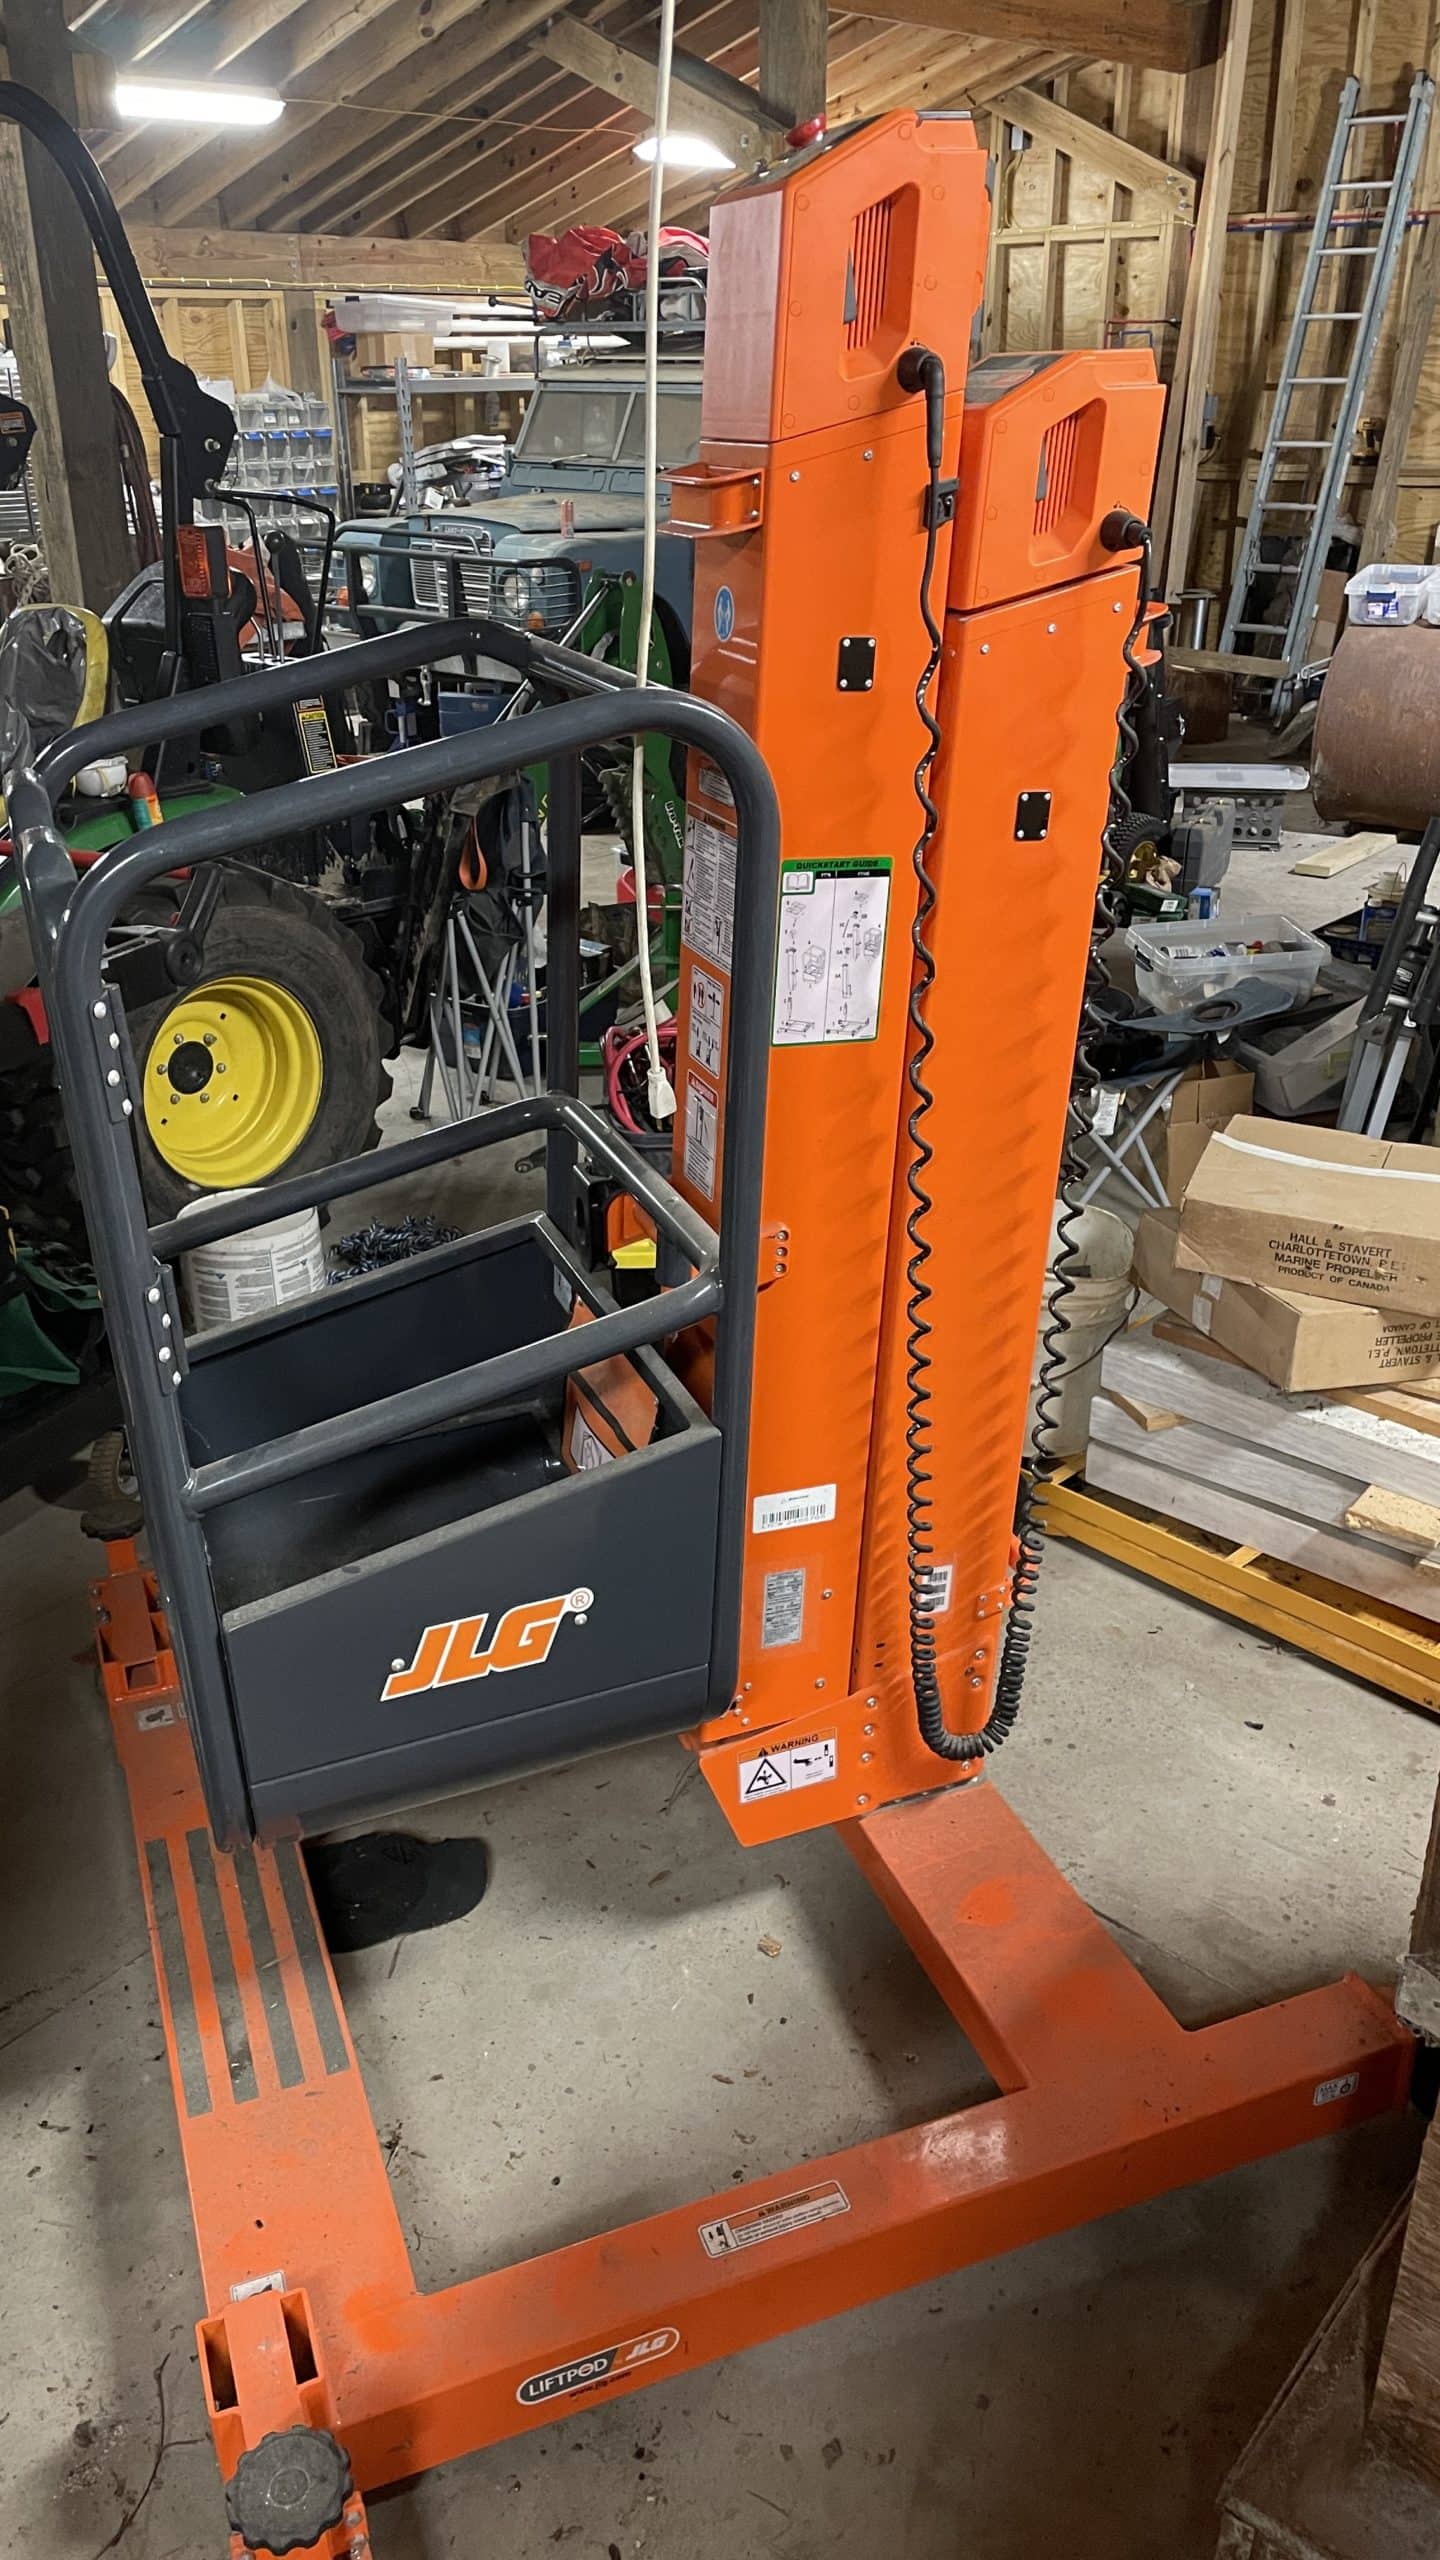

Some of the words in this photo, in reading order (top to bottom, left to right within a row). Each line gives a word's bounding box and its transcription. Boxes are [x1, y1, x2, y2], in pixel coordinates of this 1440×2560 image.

[1290, 1232, 1319, 1246] HALL
[1324, 1239, 1333, 1249] &
[1339, 1241, 1392, 1259] STAVERT
[1274, 1253, 1321, 1269] MARINE
[1278, 1265, 1325, 1281] PRODUCT
[1329, 1275, 1344, 1284] OF
[1348, 1279, 1391, 1293] CANADA
[1383, 1323, 1417, 1333] CANADA
[1419, 1321, 1431, 1330] OF
[1375, 1332, 1433, 1347] PROPELLER
[1378, 1355, 1421, 1369] STAVERT
[770, 1734, 819, 1754] WARNING
[765, 2194, 811, 2215] WARNING
[529, 2358, 608, 2397] LIFTPOD
[625, 2333, 670, 2361] JLG
